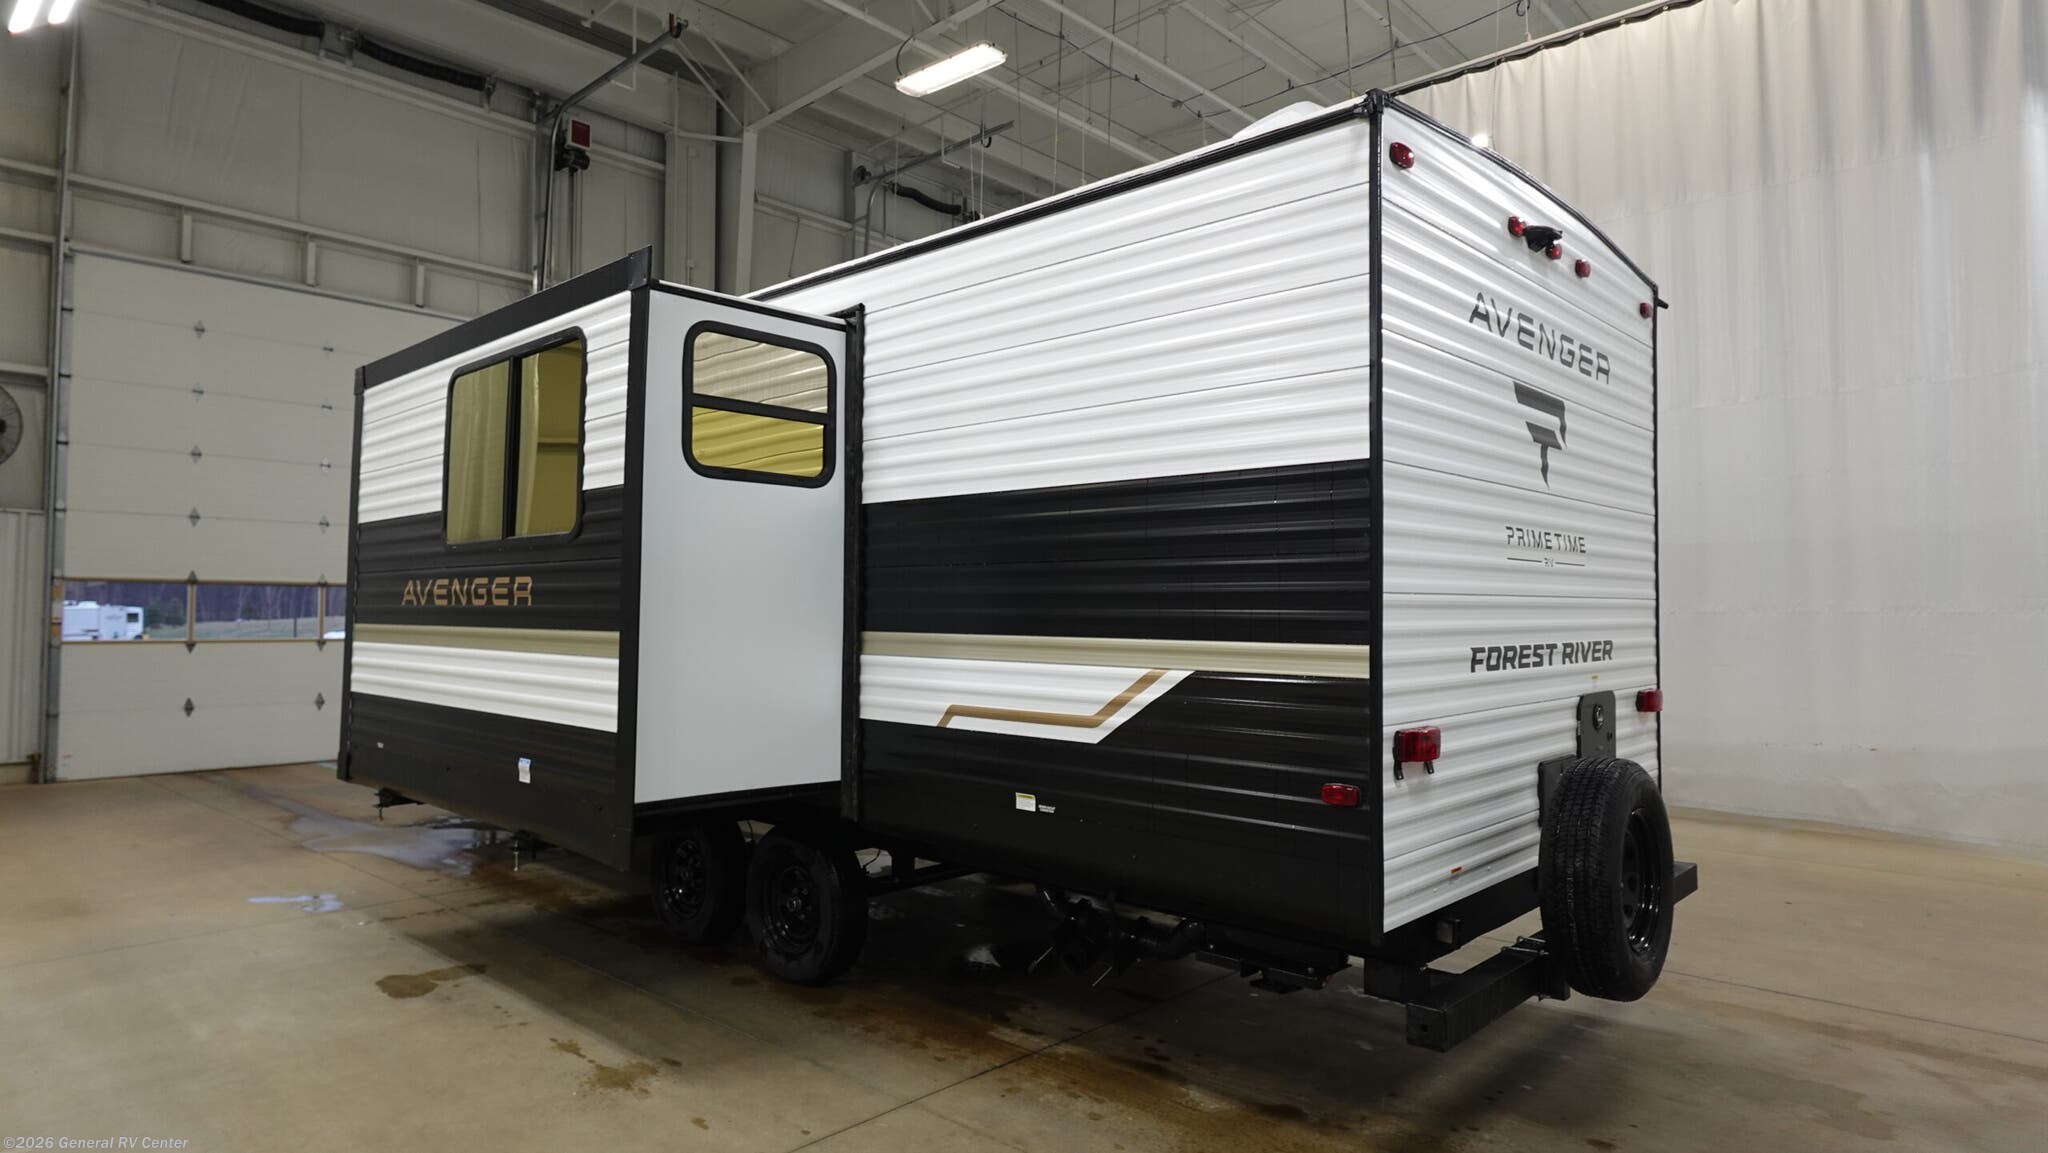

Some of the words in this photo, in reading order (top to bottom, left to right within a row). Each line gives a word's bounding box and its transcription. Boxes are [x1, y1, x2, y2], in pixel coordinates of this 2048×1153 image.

[1469, 291, 1611, 385] AVENGER
[401, 576, 533, 607] AVENGER
[1470, 643, 1558, 673] FOREST
[1561, 640, 1614, 665] RIVER
